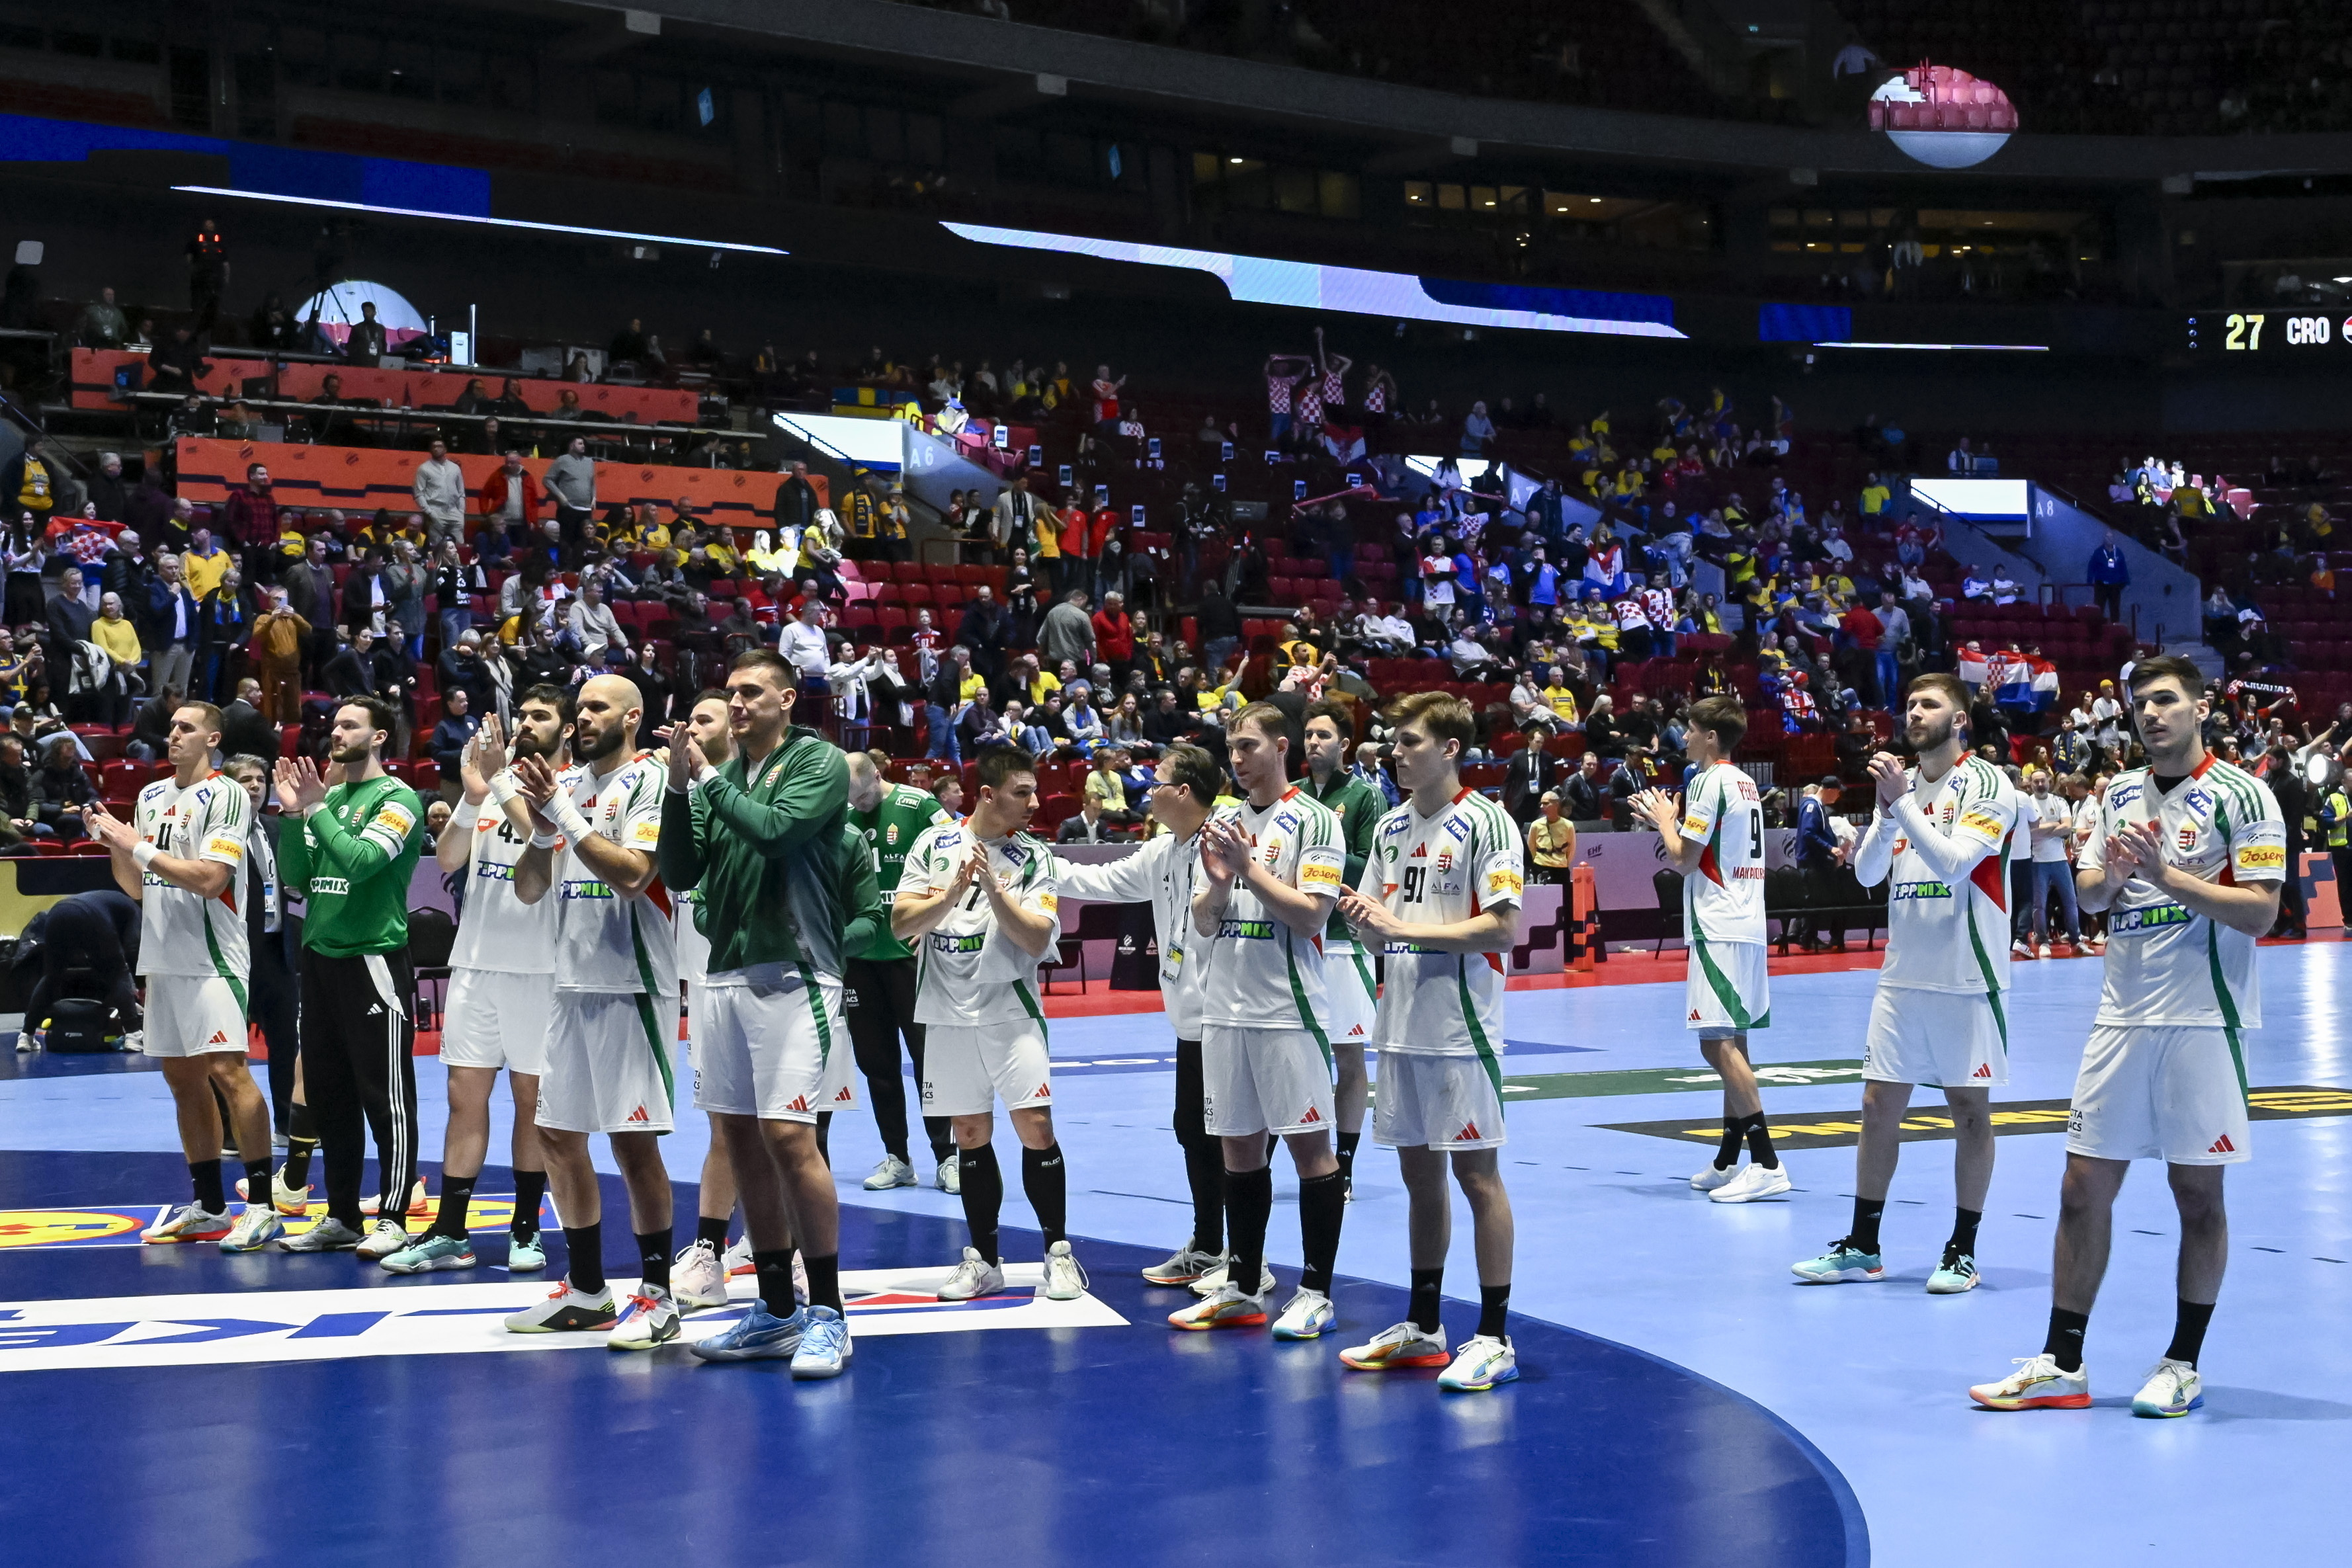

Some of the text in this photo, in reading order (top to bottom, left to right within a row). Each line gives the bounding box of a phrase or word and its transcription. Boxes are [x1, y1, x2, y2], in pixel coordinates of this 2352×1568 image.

[2226, 314, 2330, 350] 27 CRO
[909, 446, 934, 468] A 6
[1510, 486, 1534, 506] A 7
[2035, 500, 2054, 518] A 8
[155, 823, 173, 850] 11
[1448, 819, 1468, 840] JYSK
[1750, 809, 1762, 859] 9
[211, 841, 243, 858] Josera
[1587, 844, 1603, 856] EHF
[2168, 857, 2206, 866] ALFA
[1304, 867, 1341, 883] Josera
[1404, 866, 1427, 903] 91
